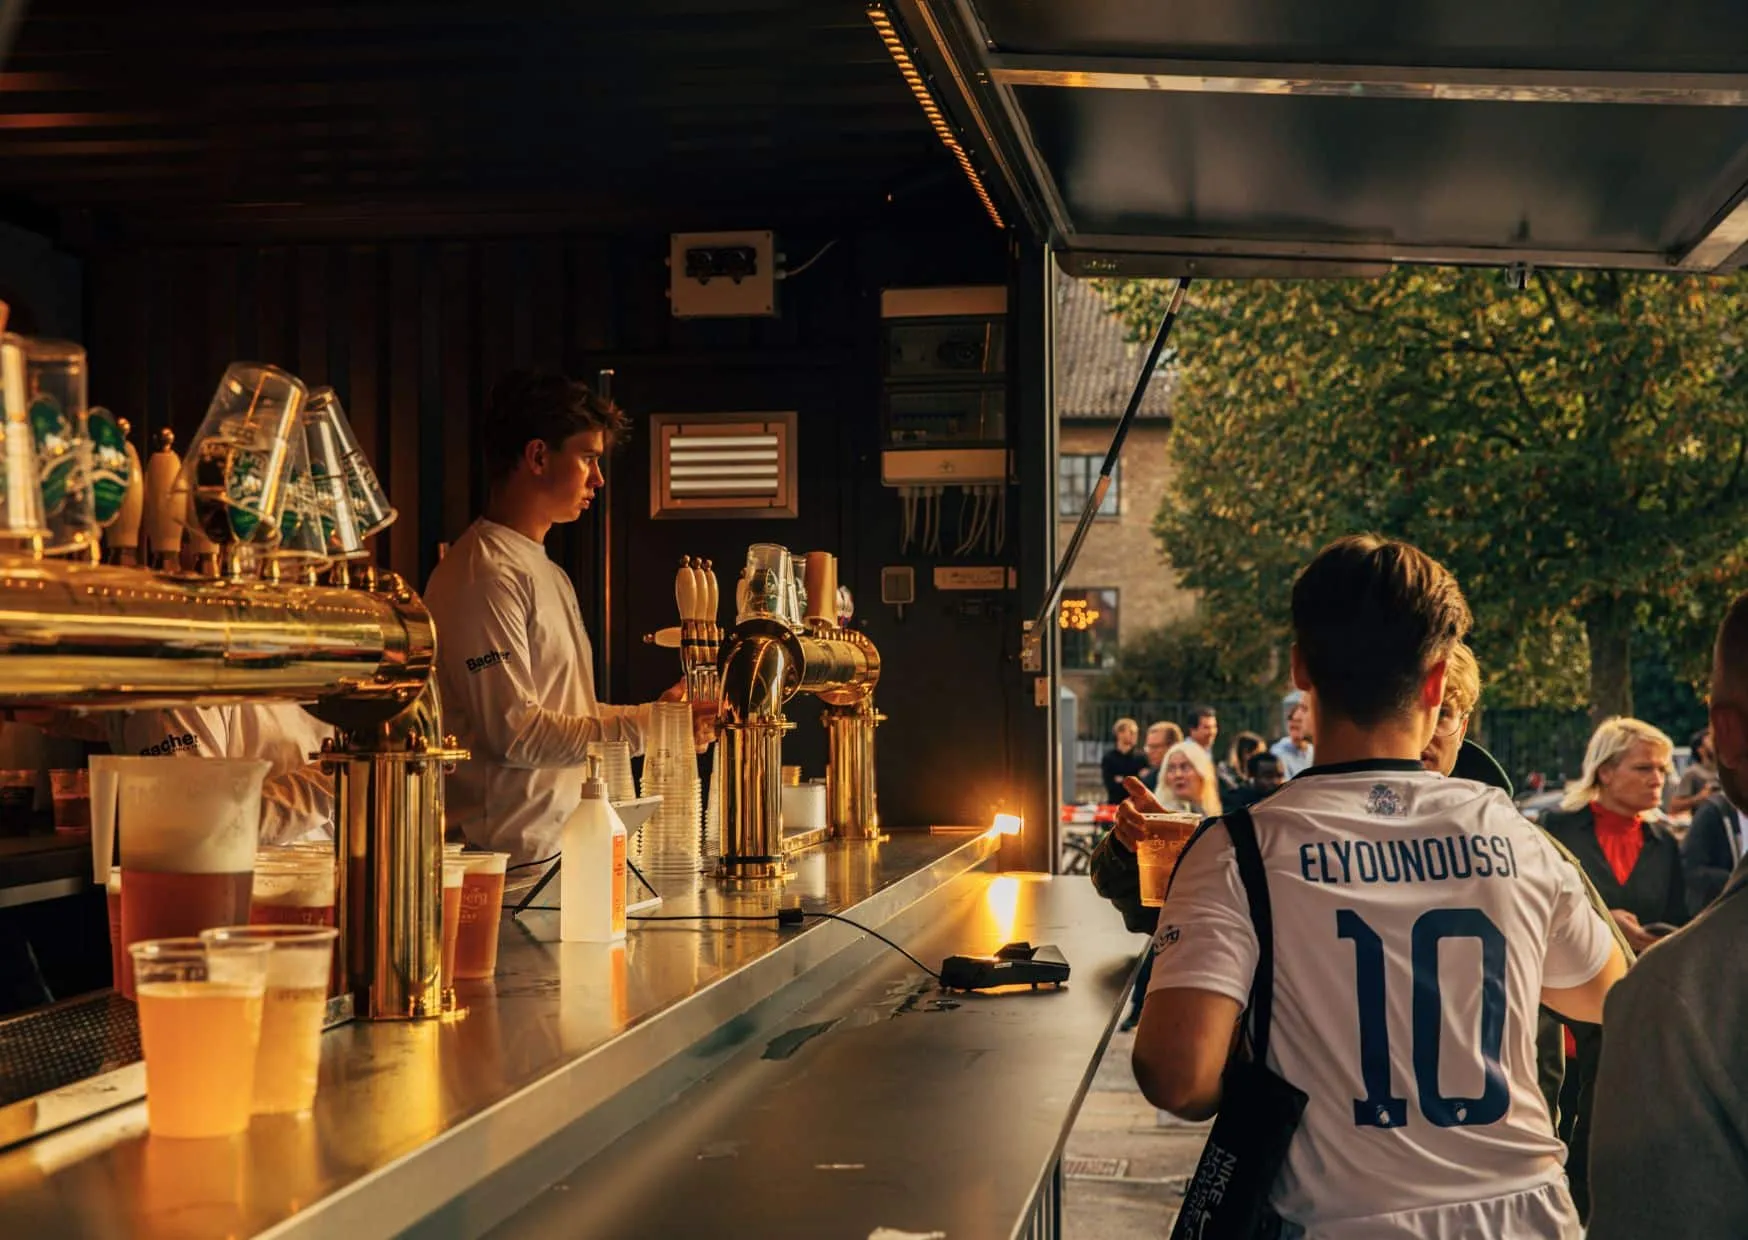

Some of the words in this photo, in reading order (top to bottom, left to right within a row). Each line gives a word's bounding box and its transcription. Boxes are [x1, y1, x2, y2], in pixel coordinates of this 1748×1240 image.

[1300, 835, 1518, 884] ELYOUNOUSSI
[1336, 908, 1511, 1128] 10
[1207, 1152, 1237, 1206] NIKE
